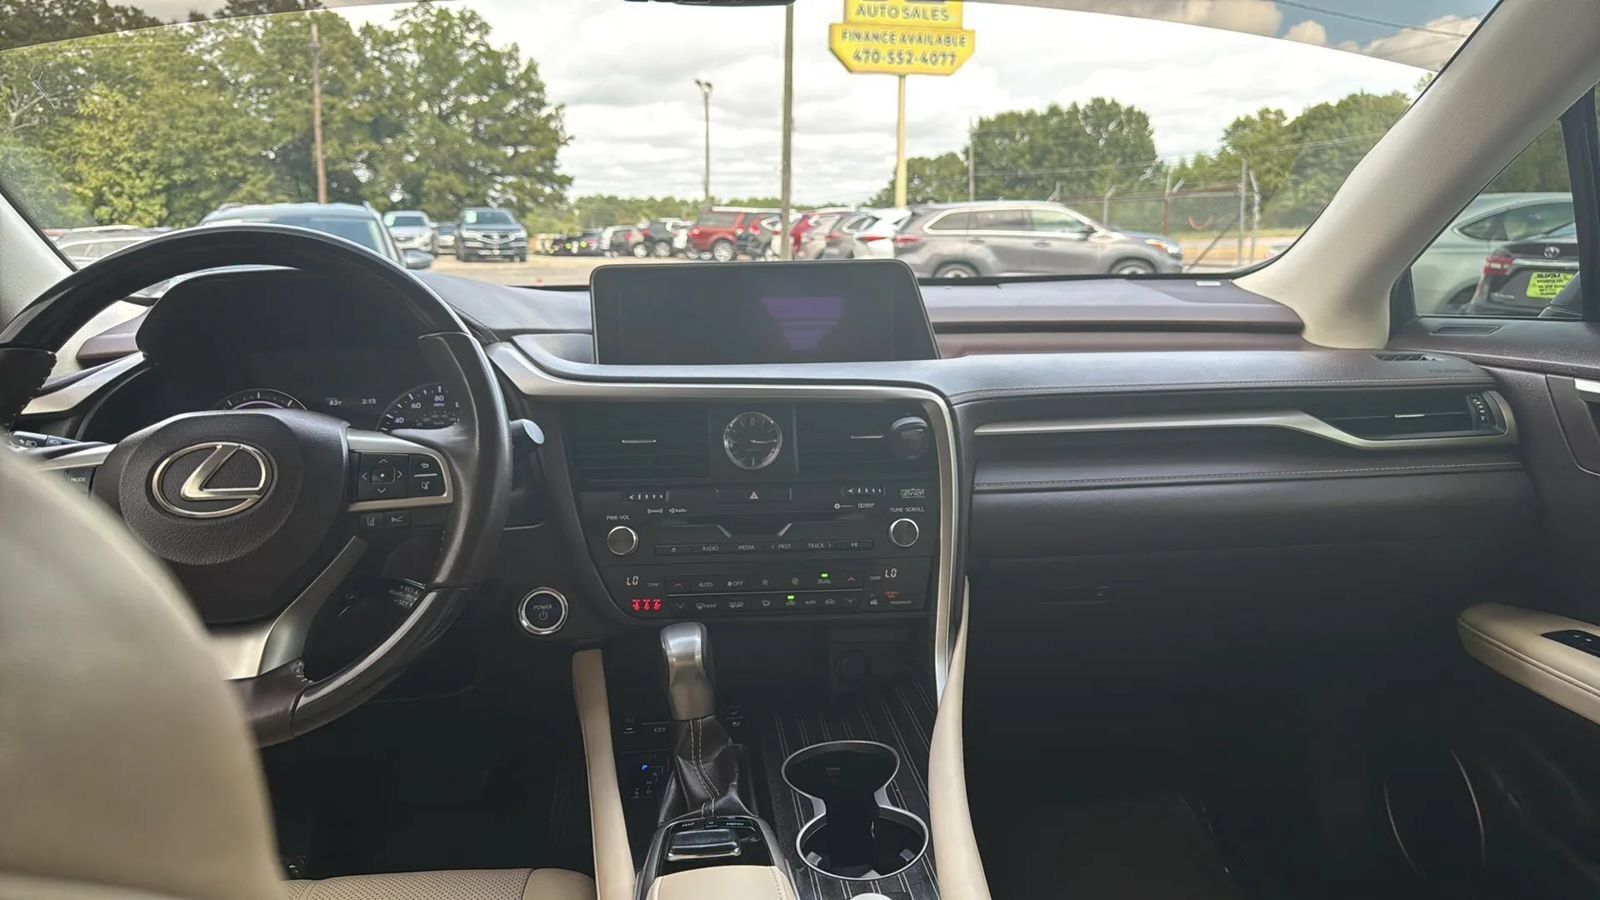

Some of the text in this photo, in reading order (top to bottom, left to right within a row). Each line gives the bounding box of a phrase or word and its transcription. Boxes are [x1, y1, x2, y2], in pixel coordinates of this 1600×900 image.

[856, 4, 950, 21] AUTO SALES
[842, 30, 967, 47] FINANCE AVAILABLE
[394, 416, 405, 424] 40
